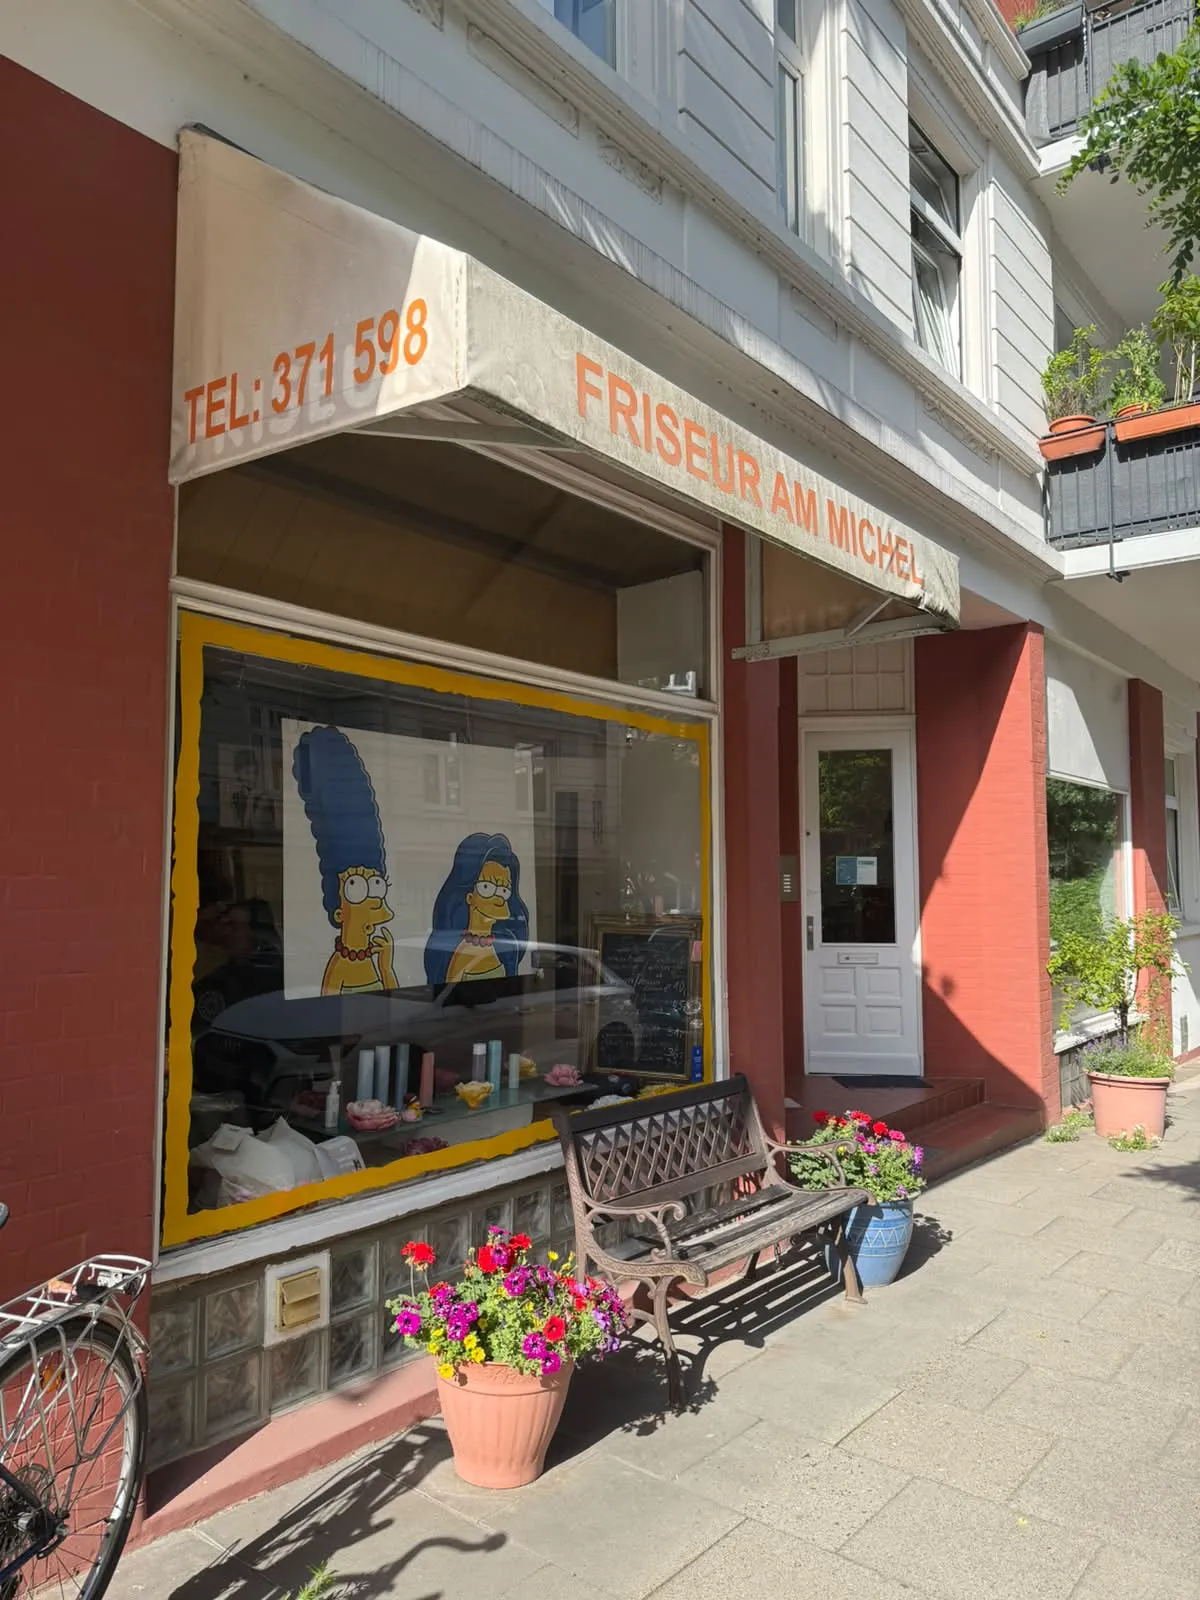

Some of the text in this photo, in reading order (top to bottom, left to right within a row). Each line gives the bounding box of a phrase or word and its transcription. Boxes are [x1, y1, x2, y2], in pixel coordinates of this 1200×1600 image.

[183, 372, 261, 445] TEL:
[271, 332, 335, 414] 371
[353, 298, 428, 384] 598
[575, 352, 925, 587] FRISEUR AM MICHEL
